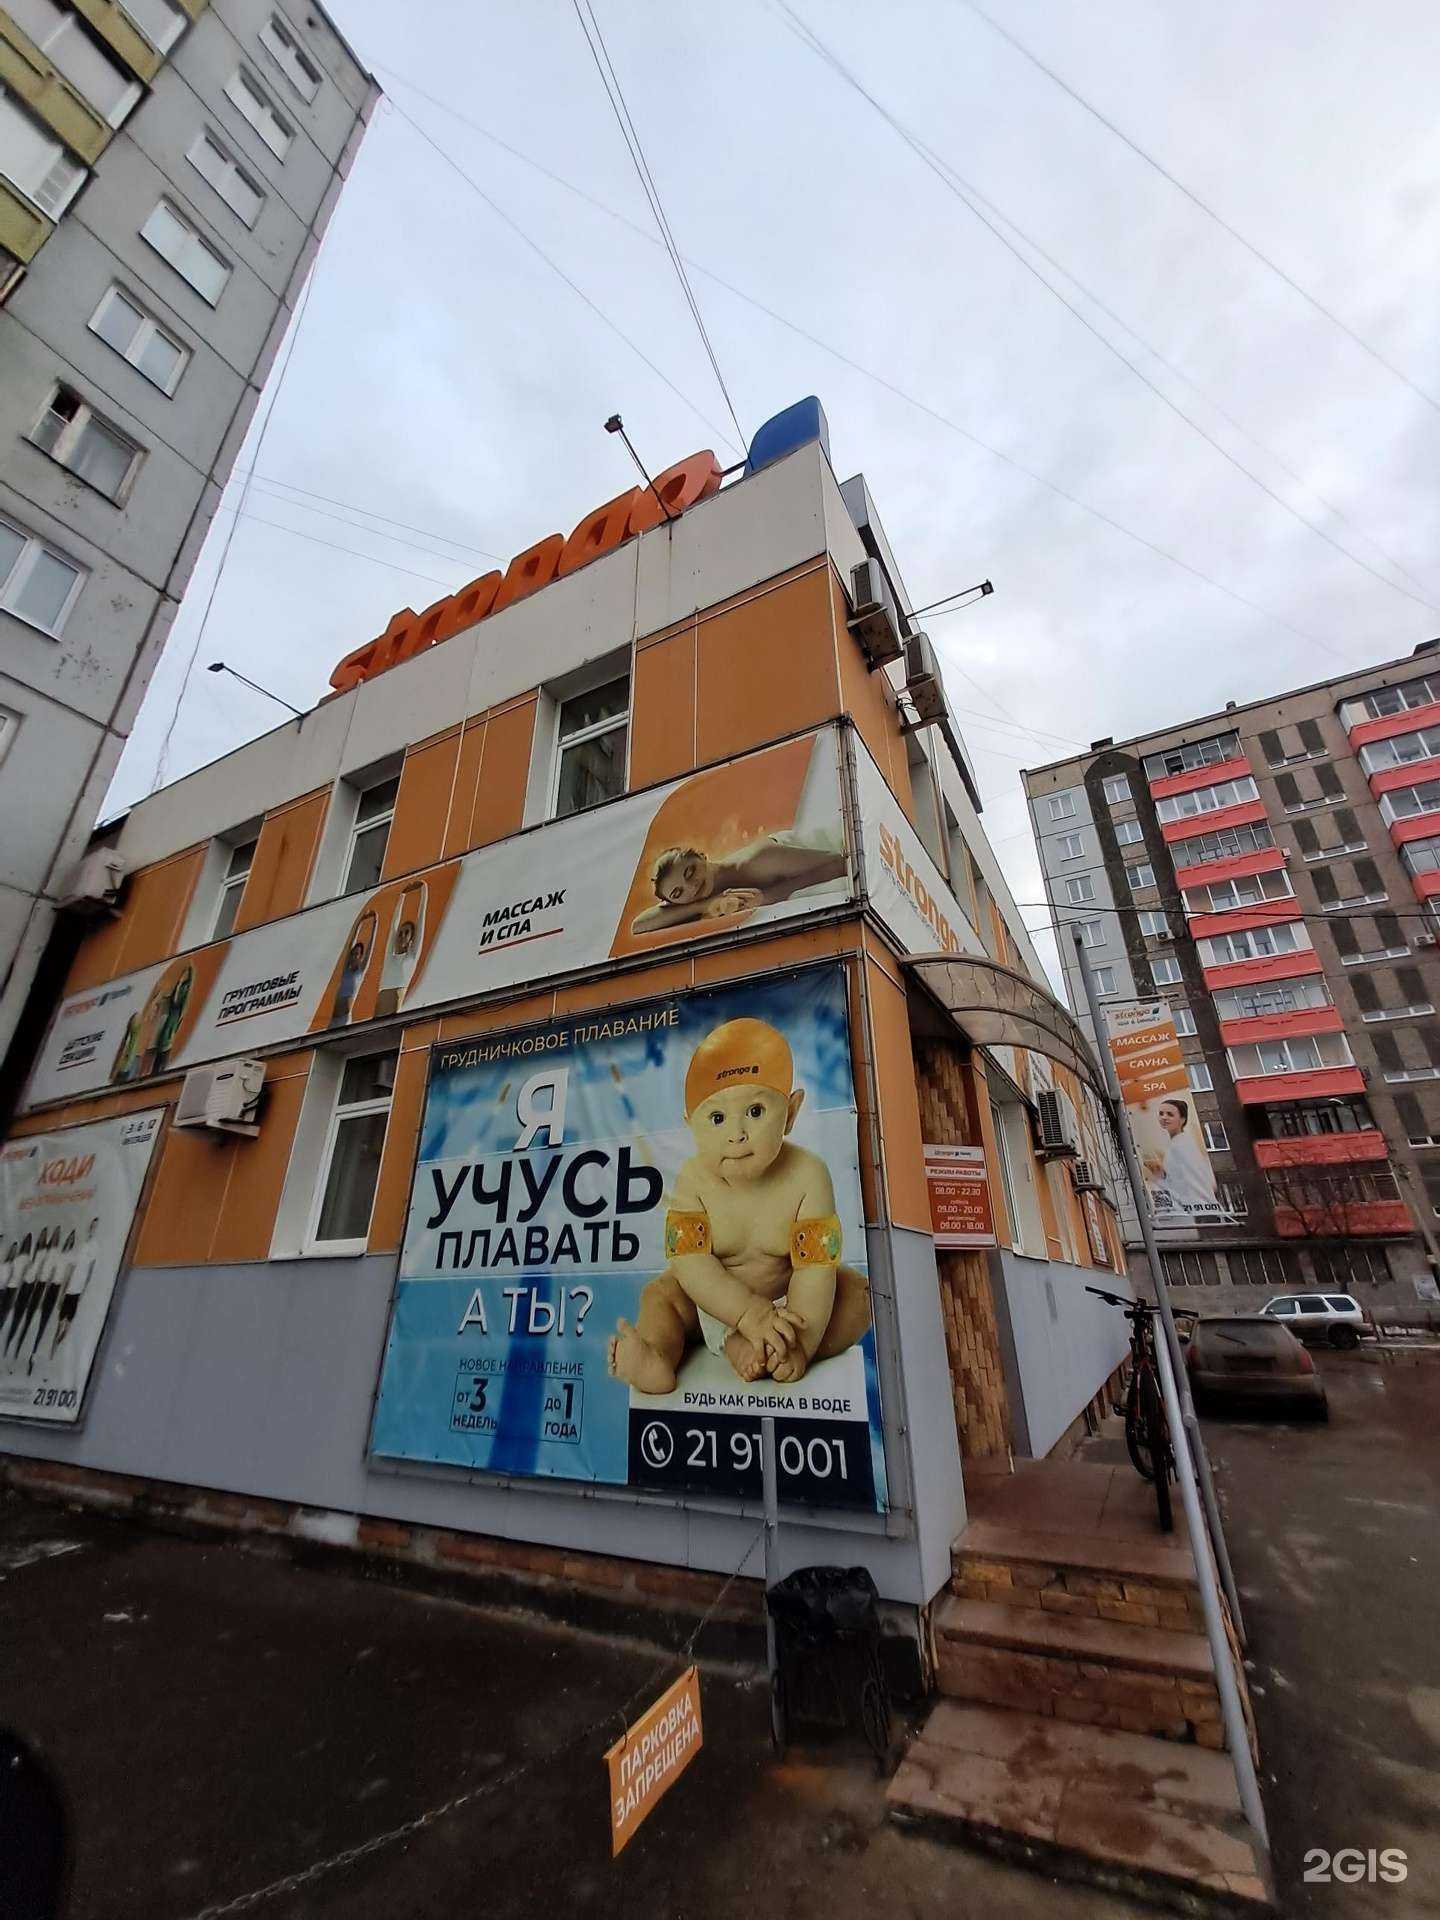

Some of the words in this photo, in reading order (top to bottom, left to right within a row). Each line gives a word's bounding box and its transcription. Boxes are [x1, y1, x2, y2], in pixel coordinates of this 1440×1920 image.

[482, 889, 566, 927] МАССАЖ
[480, 929, 494, 946] И
[496, 918, 531, 941] СПА
[217, 984, 303, 1020] ПРОГРАММЫ
[222, 970, 300, 1004] ГРУППОВЫЕ
[440, 1032, 569, 1069] ГРУДНИЧКОВОЕ
[573, 1008, 680, 1045] ПЛАВАНИЕ
[1116, 1032, 1170, 1047] МАССАЖ
[1129, 1057, 1169, 1069] САУНА
[1143, 1082, 1167, 1092] SPA
[512, 1066, 571, 1153] Я
[426, 1146, 664, 1229] УЧУСЬ
[435, 1220, 640, 1269] ПЛАВАТЬ
[457, 1287, 488, 1335] А
[502, 1285, 594, 1337] ТЫ?
[460, 1358, 496, 1371] НОВОЕ
[469, 1378, 488, 1412] 3
[563, 1383, 574, 1419] 1
[684, 1392, 716, 1405] БУДЬ
[719, 1393, 744, 1406] КАК
[750, 1395, 795, 1409] РЫБКА
[799, 1398, 807, 1409] В
[812, 1398, 851, 1413] ВОДЕ
[452, 1414, 498, 1430] НЕДЕЛЬ
[545, 1421, 578, 1438] ГОДА
[685, 1429, 718, 1468] 21
[779, 1436, 848, 1480] 001
[620, 1692, 693, 1786] ПАРКОВКА
[614, 1715, 700, 1828] ЗАПРЕЩЕНА
